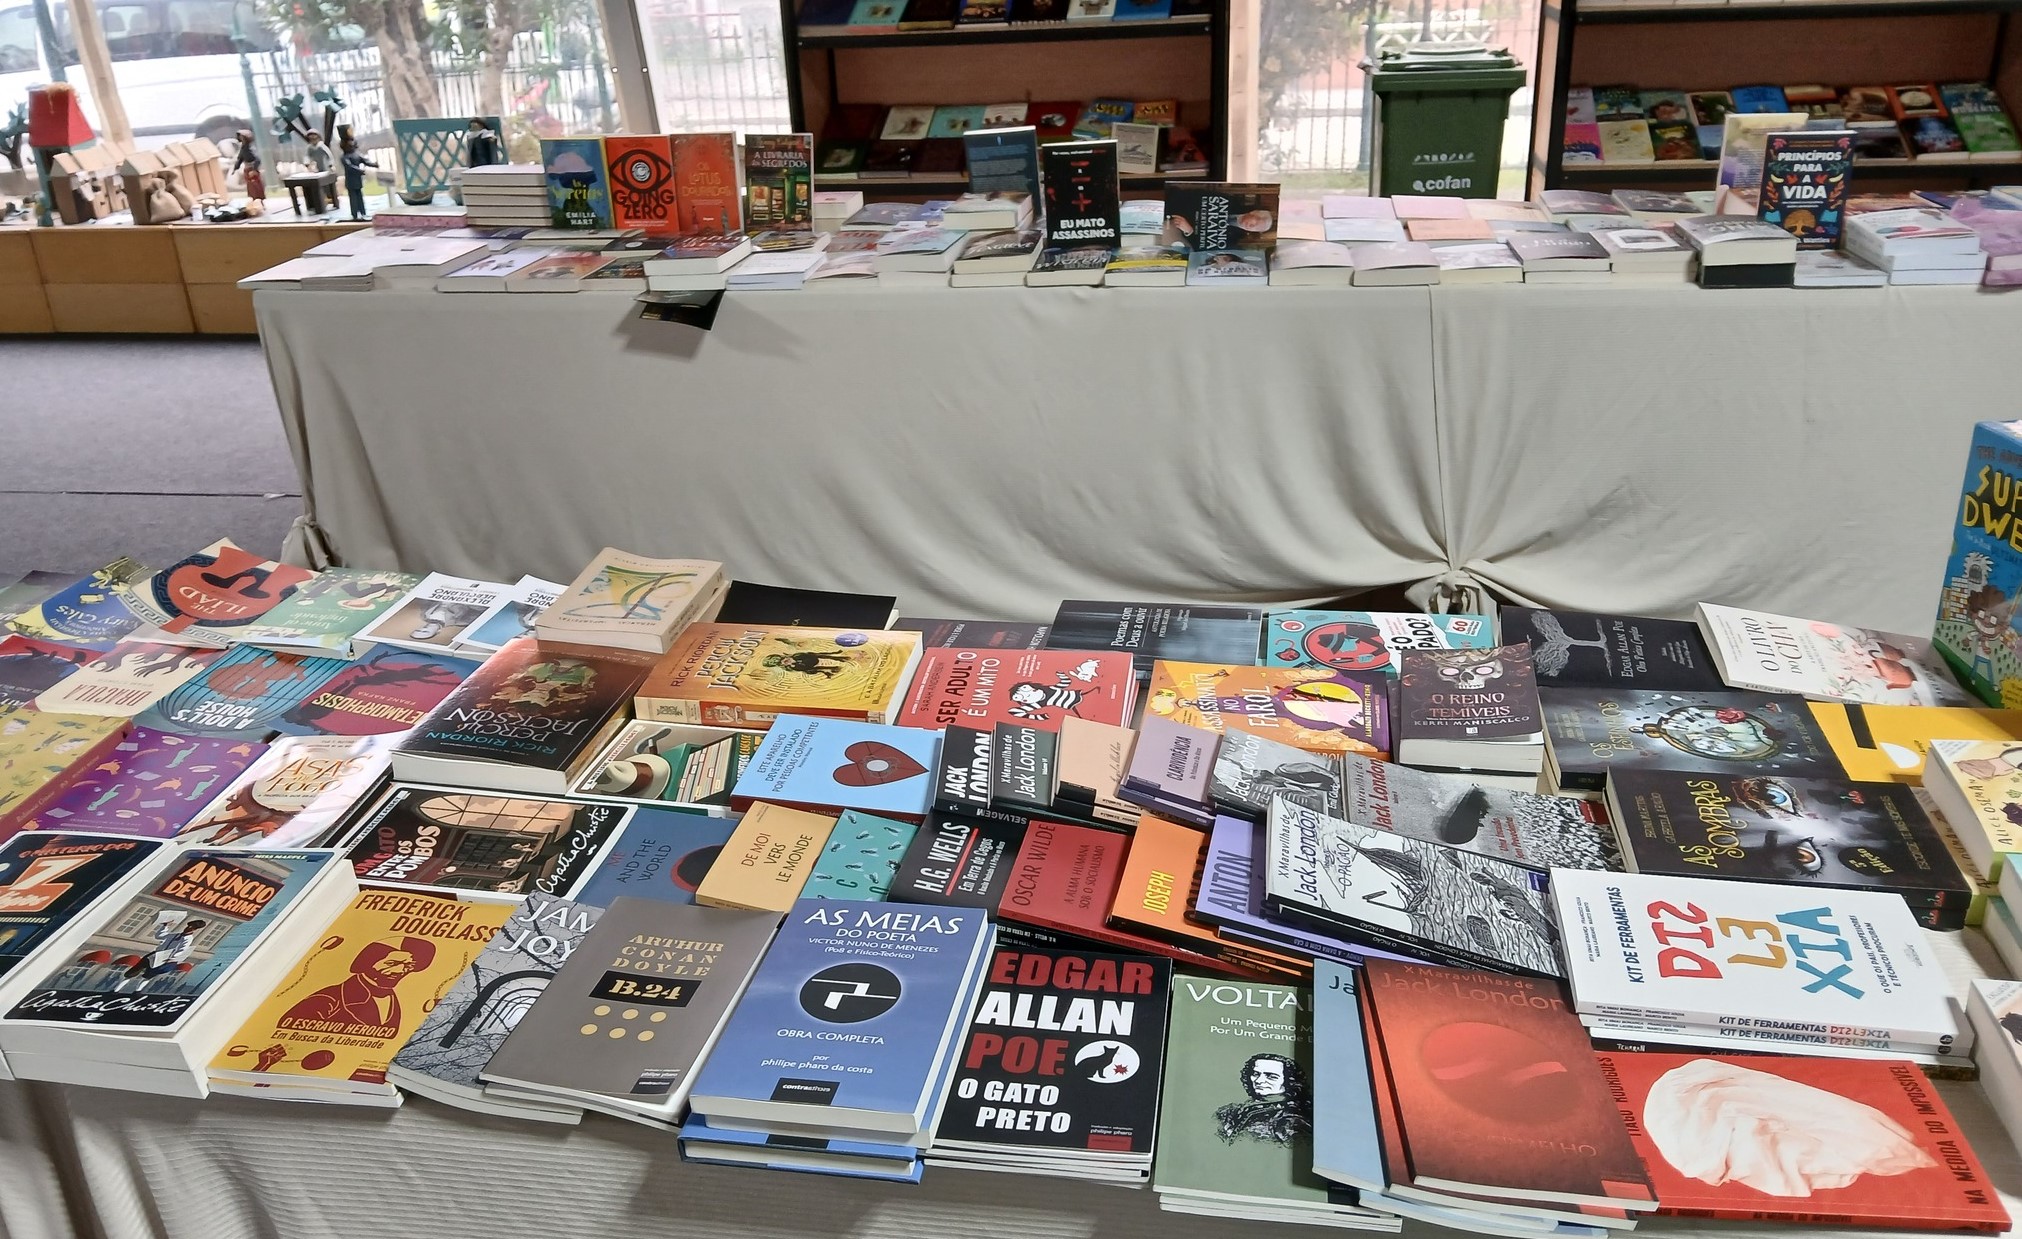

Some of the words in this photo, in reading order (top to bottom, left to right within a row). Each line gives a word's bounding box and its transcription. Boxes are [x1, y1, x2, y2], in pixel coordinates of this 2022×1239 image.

[1778, 150, 1842, 161] PRINCÍPIOS
[1793, 163, 1823, 172] PARA
[1426, 176, 1471, 190] cofan
[1802, 174, 1811, 183] A
[612, 188, 675, 206] GOING
[1783, 185, 1828, 199] VIDA
[624, 203, 668, 220] ZERO
[1060, 219, 1073, 229] EU
[1075, 218, 1106, 228] MATO
[1206, 196, 1219, 250] SARAIVA
[1217, 196, 1229, 250] ANTÓNIO
[1052, 228, 1115, 241] ASSASSINOS
[178, 585, 250, 615] ILIAD
[428, 593, 491, 605] ALEXANDRE
[1110, 620, 1129, 647] Poemas
[1125, 630, 1142, 648] Deus
[1452, 620, 1468, 632] 60
[1613, 620, 1624, 632] POE
[1740, 616, 1775, 655] LIVRO
[1616, 633, 1630, 654] ALLAN
[1765, 620, 1804, 661] CHÁ
[669, 665, 691, 687] RICK
[688, 629, 720, 667] RIORDAN
[694, 637, 739, 680] PERCY
[706, 629, 771, 691] JACKSON
[1619, 655, 1634, 678] EDGAR
[945, 651, 978, 697] ADULTO
[979, 658, 1002, 688] MITO
[62, 684, 152, 706] DRACULA
[971, 685, 992, 708] UM
[1223, 698, 1241, 711] NO
[1242, 685, 1280, 729] FAROL
[1431, 693, 1444, 705] O
[1449, 692, 1505, 705] REINO
[194, 701, 259, 718] HOUSE
[443, 707, 589, 736] JACKSON
[935, 699, 961, 724] SER
[1429, 705, 1511, 718] TEMÍVEIS
[1452, 715, 1530, 726] MANISCALCO
[234, 718, 256, 730] A
[424, 731, 512, 746] RIORDAN
[512, 741, 557, 755] RICK
[779, 728, 803, 758] INSTALADO
[1014, 727, 1036, 772] London
[757, 760, 772, 774] ESTE
[767, 733, 787, 762] APARELHO
[771, 759, 783, 769] SER
[772, 781, 785, 793] POR
[779, 758, 799, 780] PESSOAS
[793, 721, 819, 759] COMPETENTES
[1165, 735, 1191, 782] CLARIVIDÊNCIA
[1238, 734, 1262, 776] London
[765, 768, 780, 782] DEVE
[969, 732, 991, 803] LONDON
[1366, 759, 1389, 802] London
[944, 765, 968, 798] JACK
[1014, 773, 1036, 798] Jack
[1226, 776, 1252, 802] Jack
[976, 808, 1028, 825] SELVAGEM
[1369, 803, 1393, 831] Jack
[1686, 780, 1749, 859] SOMBRAS
[377, 827, 397, 859] GATO
[384, 825, 441, 879] POMBOS
[535, 849, 580, 894] Agatha
[571, 805, 610, 850] Christie
[741, 852, 759, 868] DE
[750, 832, 772, 854] MOI
[927, 822, 970, 863] WELLS
[1026, 823, 1056, 861] WILDE
[1294, 809, 1317, 869] London
[366, 852, 405, 877] ENTRE
[398, 839, 414, 855] OS
[617, 860, 641, 884] AND
[632, 838, 656, 859] THE
[636, 844, 672, 882] WORLD
[763, 842, 787, 866] VERS
[783, 833, 813, 872] MONDE
[1678, 843, 1719, 869] AS
[1857, 847, 1895, 874] Edição
[775, 870, 792, 883] LE
[962, 865, 982, 882] Terra
[1065, 876, 1081, 898] ALMA
[1073, 844, 1090, 876] HUMANA
[1088, 845, 1105, 887] SOCIALISMO
[178, 861, 276, 904] ANÚNCIO
[913, 867, 951, 893] H.G.
[958, 881, 975, 892] Em
[1011, 864, 1042, 906] OSCAR
[1142, 869, 1175, 916] JOSEPH
[1206, 849, 1255, 915] ANTON
[1294, 869, 1318, 900] Jack
[162, 879, 192, 900] DE
[189, 888, 218, 908] UM
[213, 895, 262, 918] CRIME
[354, 893, 472, 922] FREDERICK
[804, 908, 849, 928] AS
[854, 910, 965, 935] MEIAS
[1606, 886, 1637, 944] FERRAMENTAS
[388, 915, 502, 943] DOUGLASS
[835, 928, 863, 939] DO
[866, 930, 917, 943] POETA
[498, 929, 586, 961] JOY
[620, 946, 718, 964] CONAN
[629, 934, 725, 952] ARTHUR
[808, 937, 845, 946] VICTOR
[846, 940, 878, 949] NUNO
[881, 943, 895, 951] DE
[896, 944, 939, 953] MENEZES
[853, 947, 915, 960] Físico-Teórico)
[1626, 946, 1641, 964] DE
[1775, 906, 1866, 1000] XIA
[612, 957, 712, 976] DOYLE
[989, 951, 1155, 994] EDGAR
[1418, 968, 1511, 988] Maravilhas
[1513, 980, 1535, 989] de
[1629, 965, 1645, 984] KIT
[19, 990, 103, 1012] Agatha
[98, 995, 191, 1014] Christie
[608, 979, 682, 1000] B.24
[1380, 972, 1440, 995] Jack
[1452, 982, 1567, 1012] London
[280, 1017, 293, 1028] O
[292, 1018, 345, 1034] ESCRAVO
[974, 990, 1135, 1036] ALLAN
[1220, 1017, 1242, 1026] Um
[1245, 1019, 1297, 1032] Pequeno
[1719, 1016, 1736, 1026] KIT
[1738, 1017, 1751, 1027] DE
[1754, 1019, 1828, 1034] FERRAMENTAS
[270, 1030, 289, 1040] Em
[289, 1032, 318, 1043] Busca
[319, 1034, 335, 1044] da
[334, 1037, 385, 1050] Liberdade
[776, 1028, 813, 1040] OBRA
[815, 1031, 886, 1045] COMPLETA
[1210, 1025, 1231, 1035] Por
[1234, 1028, 1256, 1038] Um
[1719, 1028, 1736, 1037] KIT
[1738, 1029, 1751, 1039] DE
[1754, 1031, 1828, 1045] FERRAMENTAS
[760, 1057, 796, 1069] philipe
[797, 1060, 829, 1071] pharo
[831, 1062, 845, 1072] da
[846, 1065, 874, 1075] costa
[812, 1054, 830, 1062] por
[957, 1077, 979, 1099] O
[983, 1080, 1060, 1106] GATO
[1887, 1064, 1938, 1117] IMPOSSÍVEL
[975, 1105, 1072, 1133] PRETO
[1620, 1108, 1642, 1137] TIAGO
[1924, 1119, 1949, 1136] DO
[1936, 1139, 1977, 1182] MEDIDA
[1964, 1188, 1990, 1205] NA
